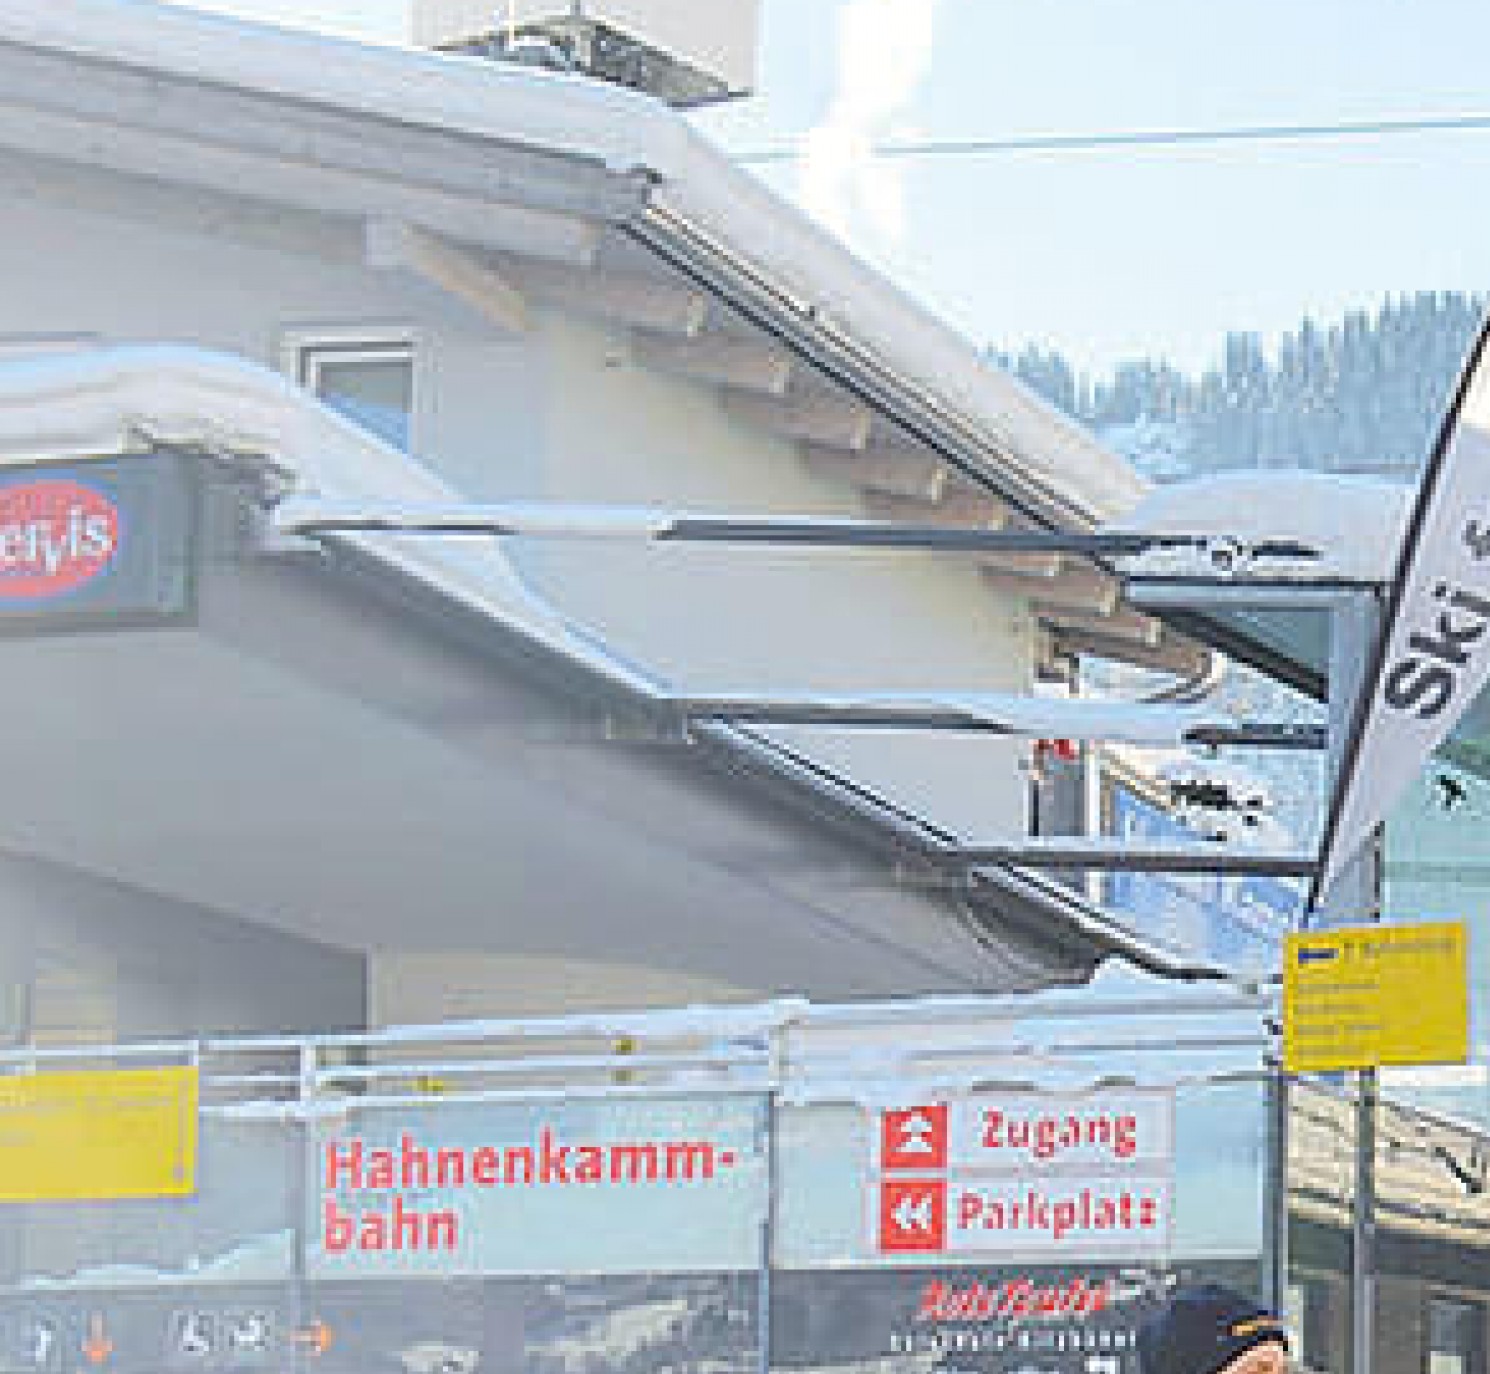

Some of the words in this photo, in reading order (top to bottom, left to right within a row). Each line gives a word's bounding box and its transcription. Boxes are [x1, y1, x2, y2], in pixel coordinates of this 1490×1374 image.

[324, 1124, 736, 1190] Hahnenkamm-
[981, 1109, 1137, 1159] Zugang
[324, 1195, 460, 1252] bahn
[956, 1189, 1157, 1240] Parkplatz
